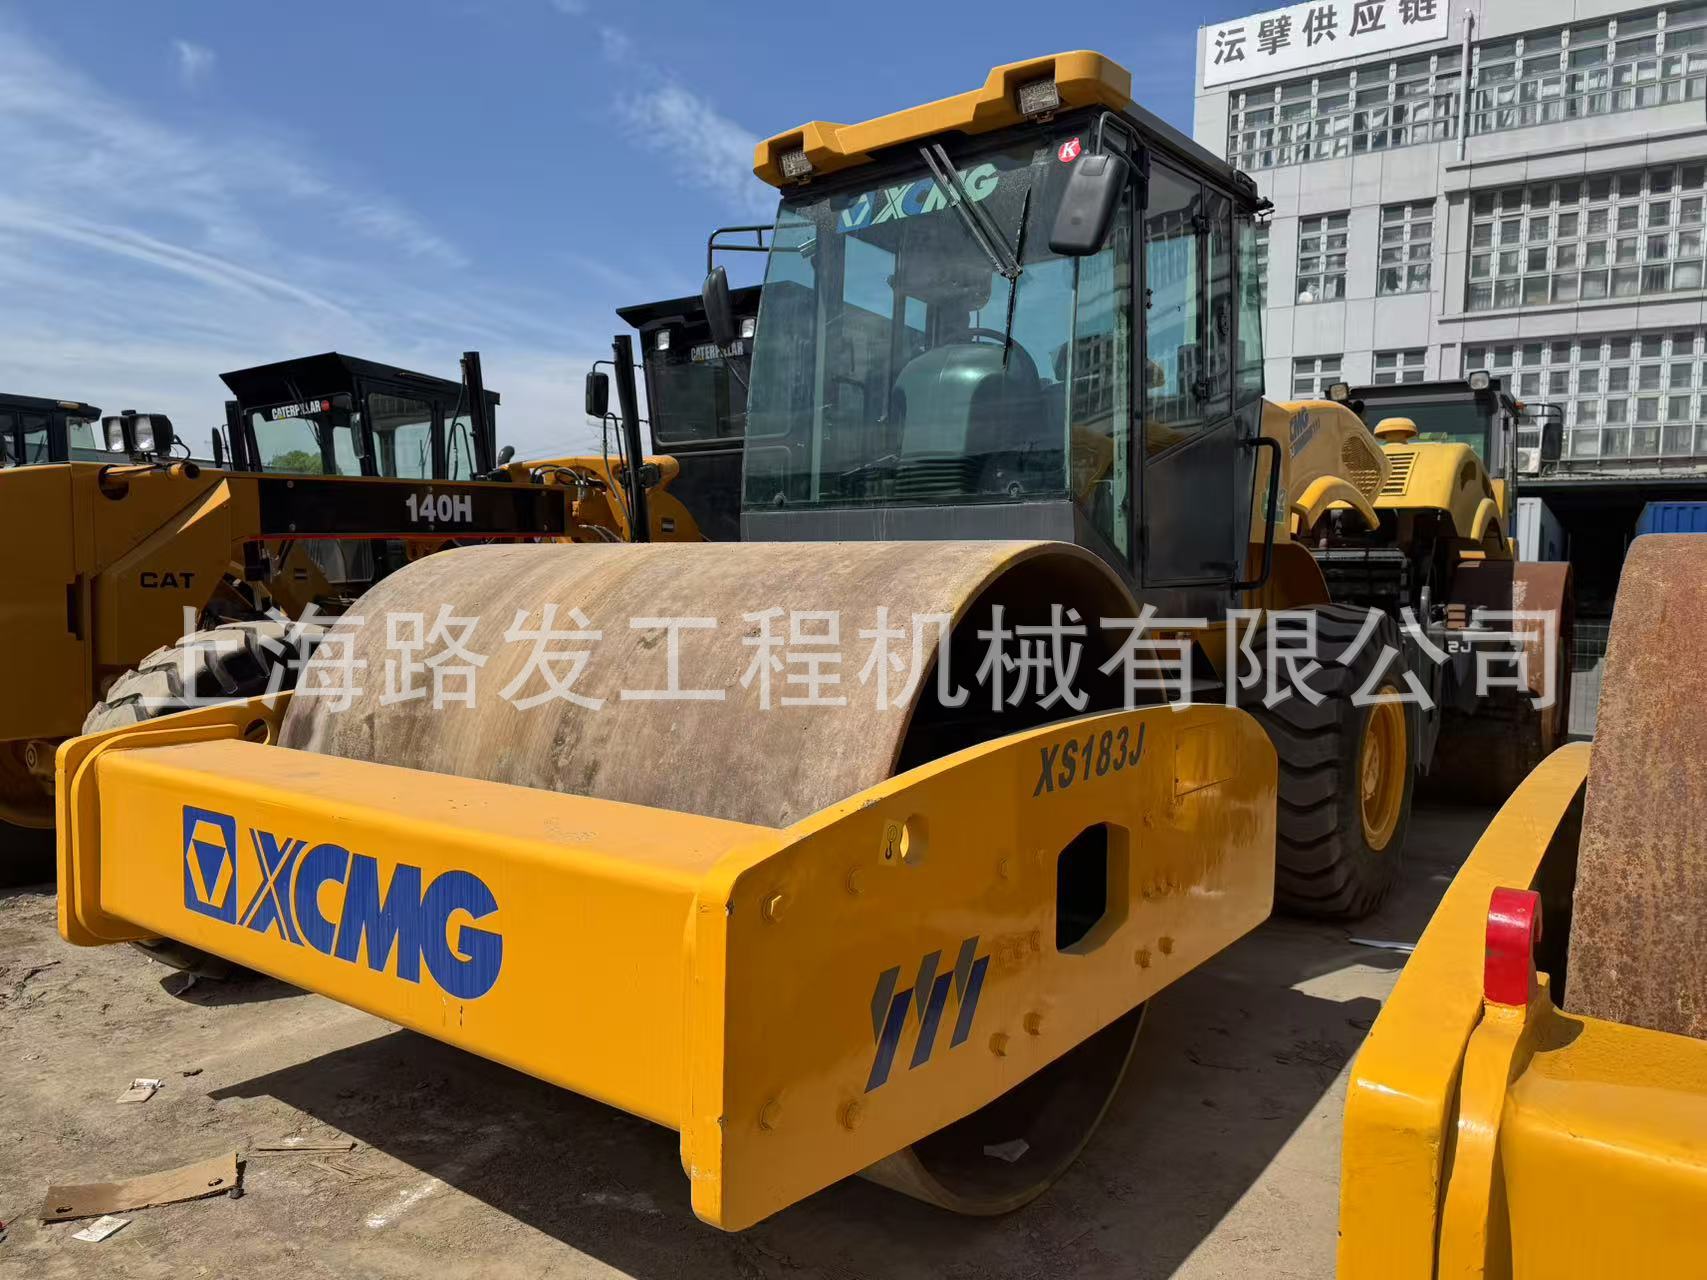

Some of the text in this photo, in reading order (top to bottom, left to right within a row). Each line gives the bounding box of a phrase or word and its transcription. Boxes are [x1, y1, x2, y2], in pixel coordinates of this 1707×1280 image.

[870, 163, 999, 225] XCMG
[405, 493, 473, 522] 140H
[140, 572, 195, 589] CAT
[1032, 721, 1145, 798] XS183J
[237, 827, 503, 1000] XCMG
